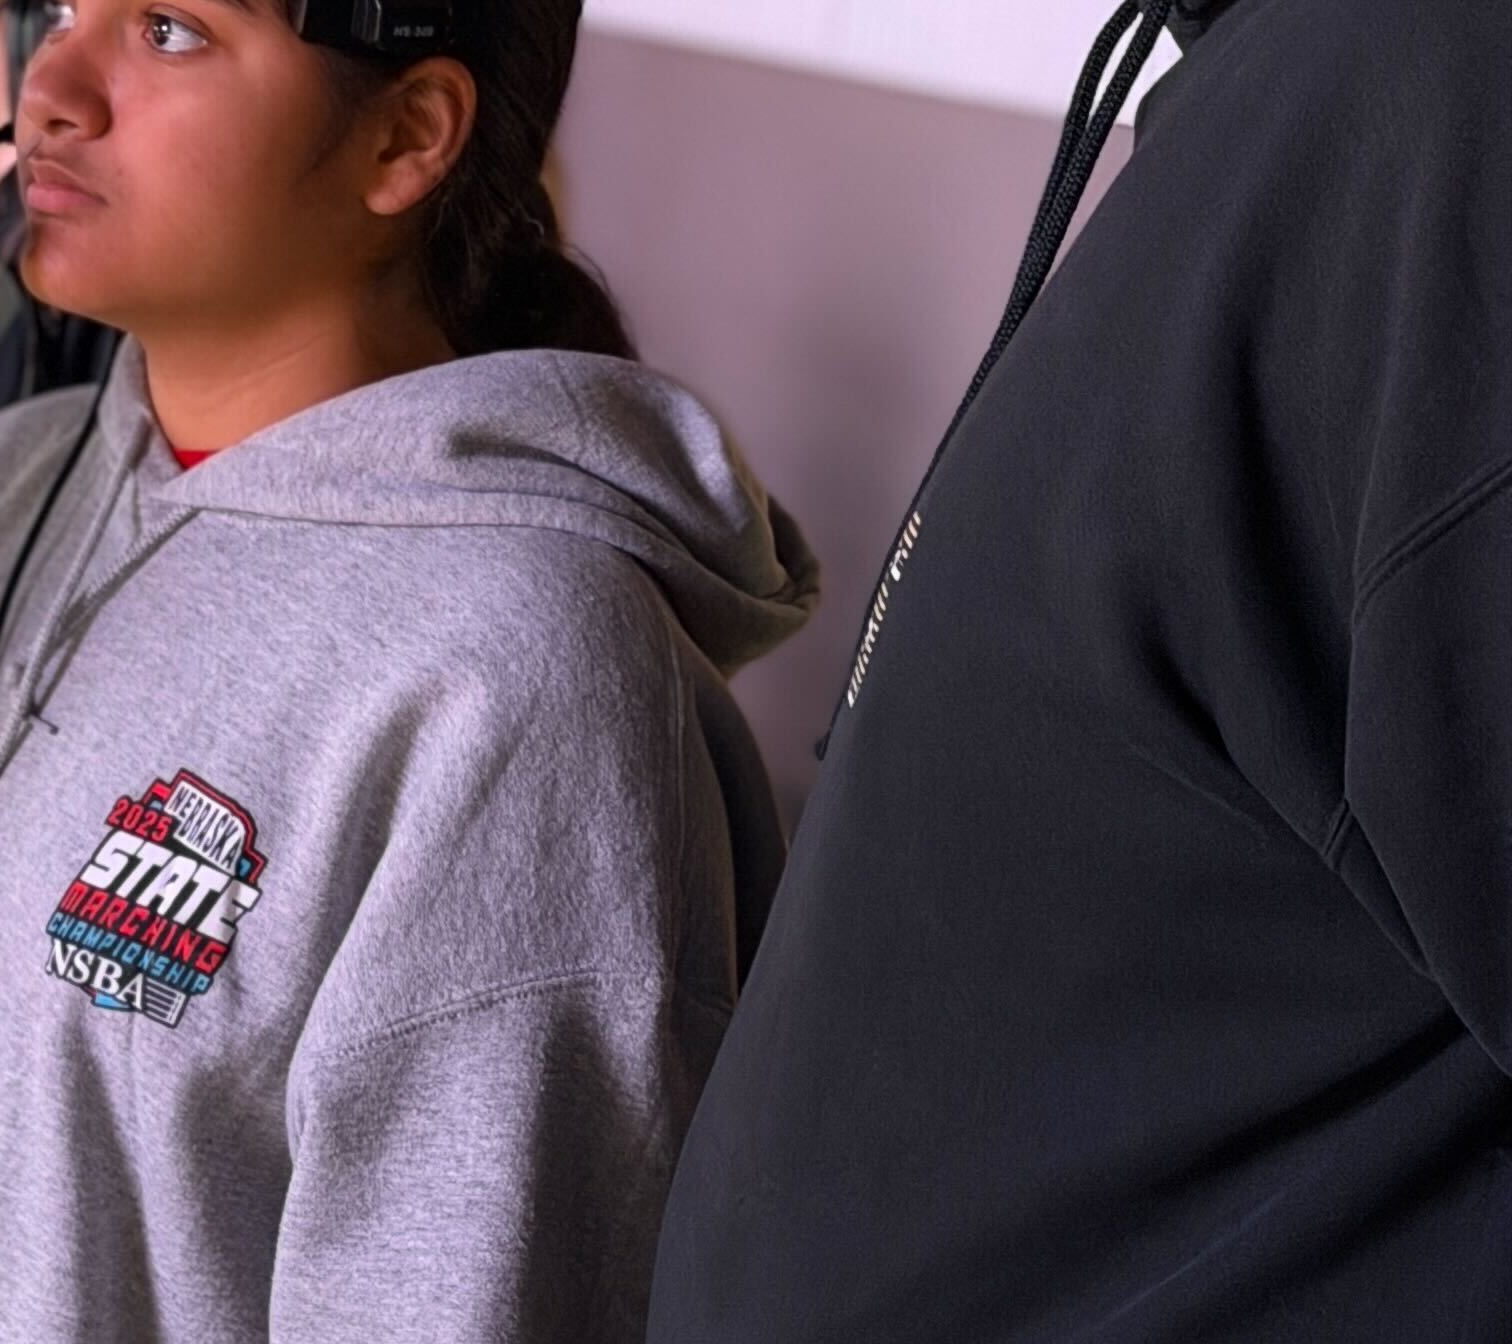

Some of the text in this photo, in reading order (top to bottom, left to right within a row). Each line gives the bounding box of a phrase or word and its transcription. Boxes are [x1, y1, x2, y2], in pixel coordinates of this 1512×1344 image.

[107, 798, 172, 843] 2025
[167, 786, 242, 869] NEBRASKA
[59, 880, 228, 974] MARCHING
[80, 830, 263, 944] STATE
[46, 938, 148, 1010] NSBA
[48, 912, 211, 992] CHAMPIONSHIP
